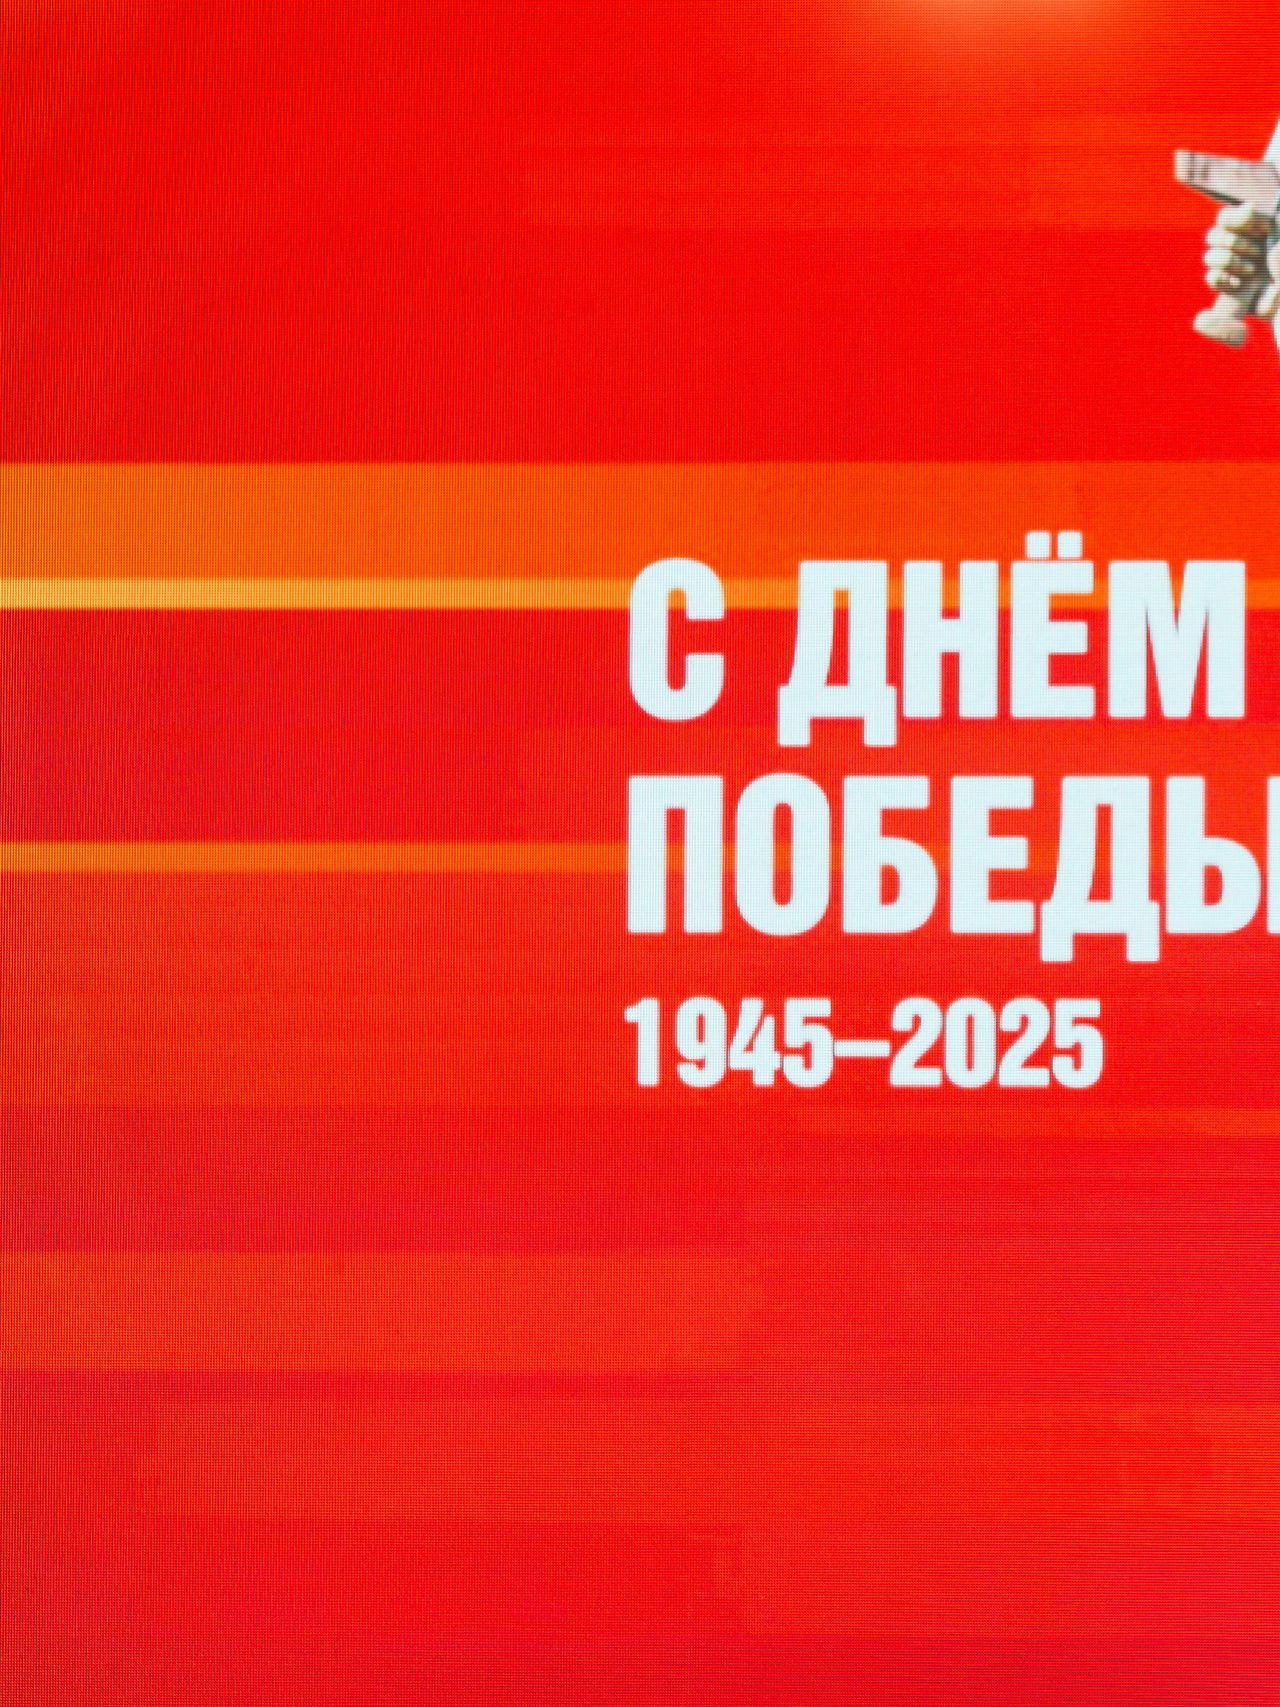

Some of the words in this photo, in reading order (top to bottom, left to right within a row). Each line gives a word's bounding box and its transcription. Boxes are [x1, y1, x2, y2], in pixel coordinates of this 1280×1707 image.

[628, 556, 726, 722] С
[776, 530, 1247, 749] ДНЁМ
[623, 996, 1105, 1090] 1945–2025
